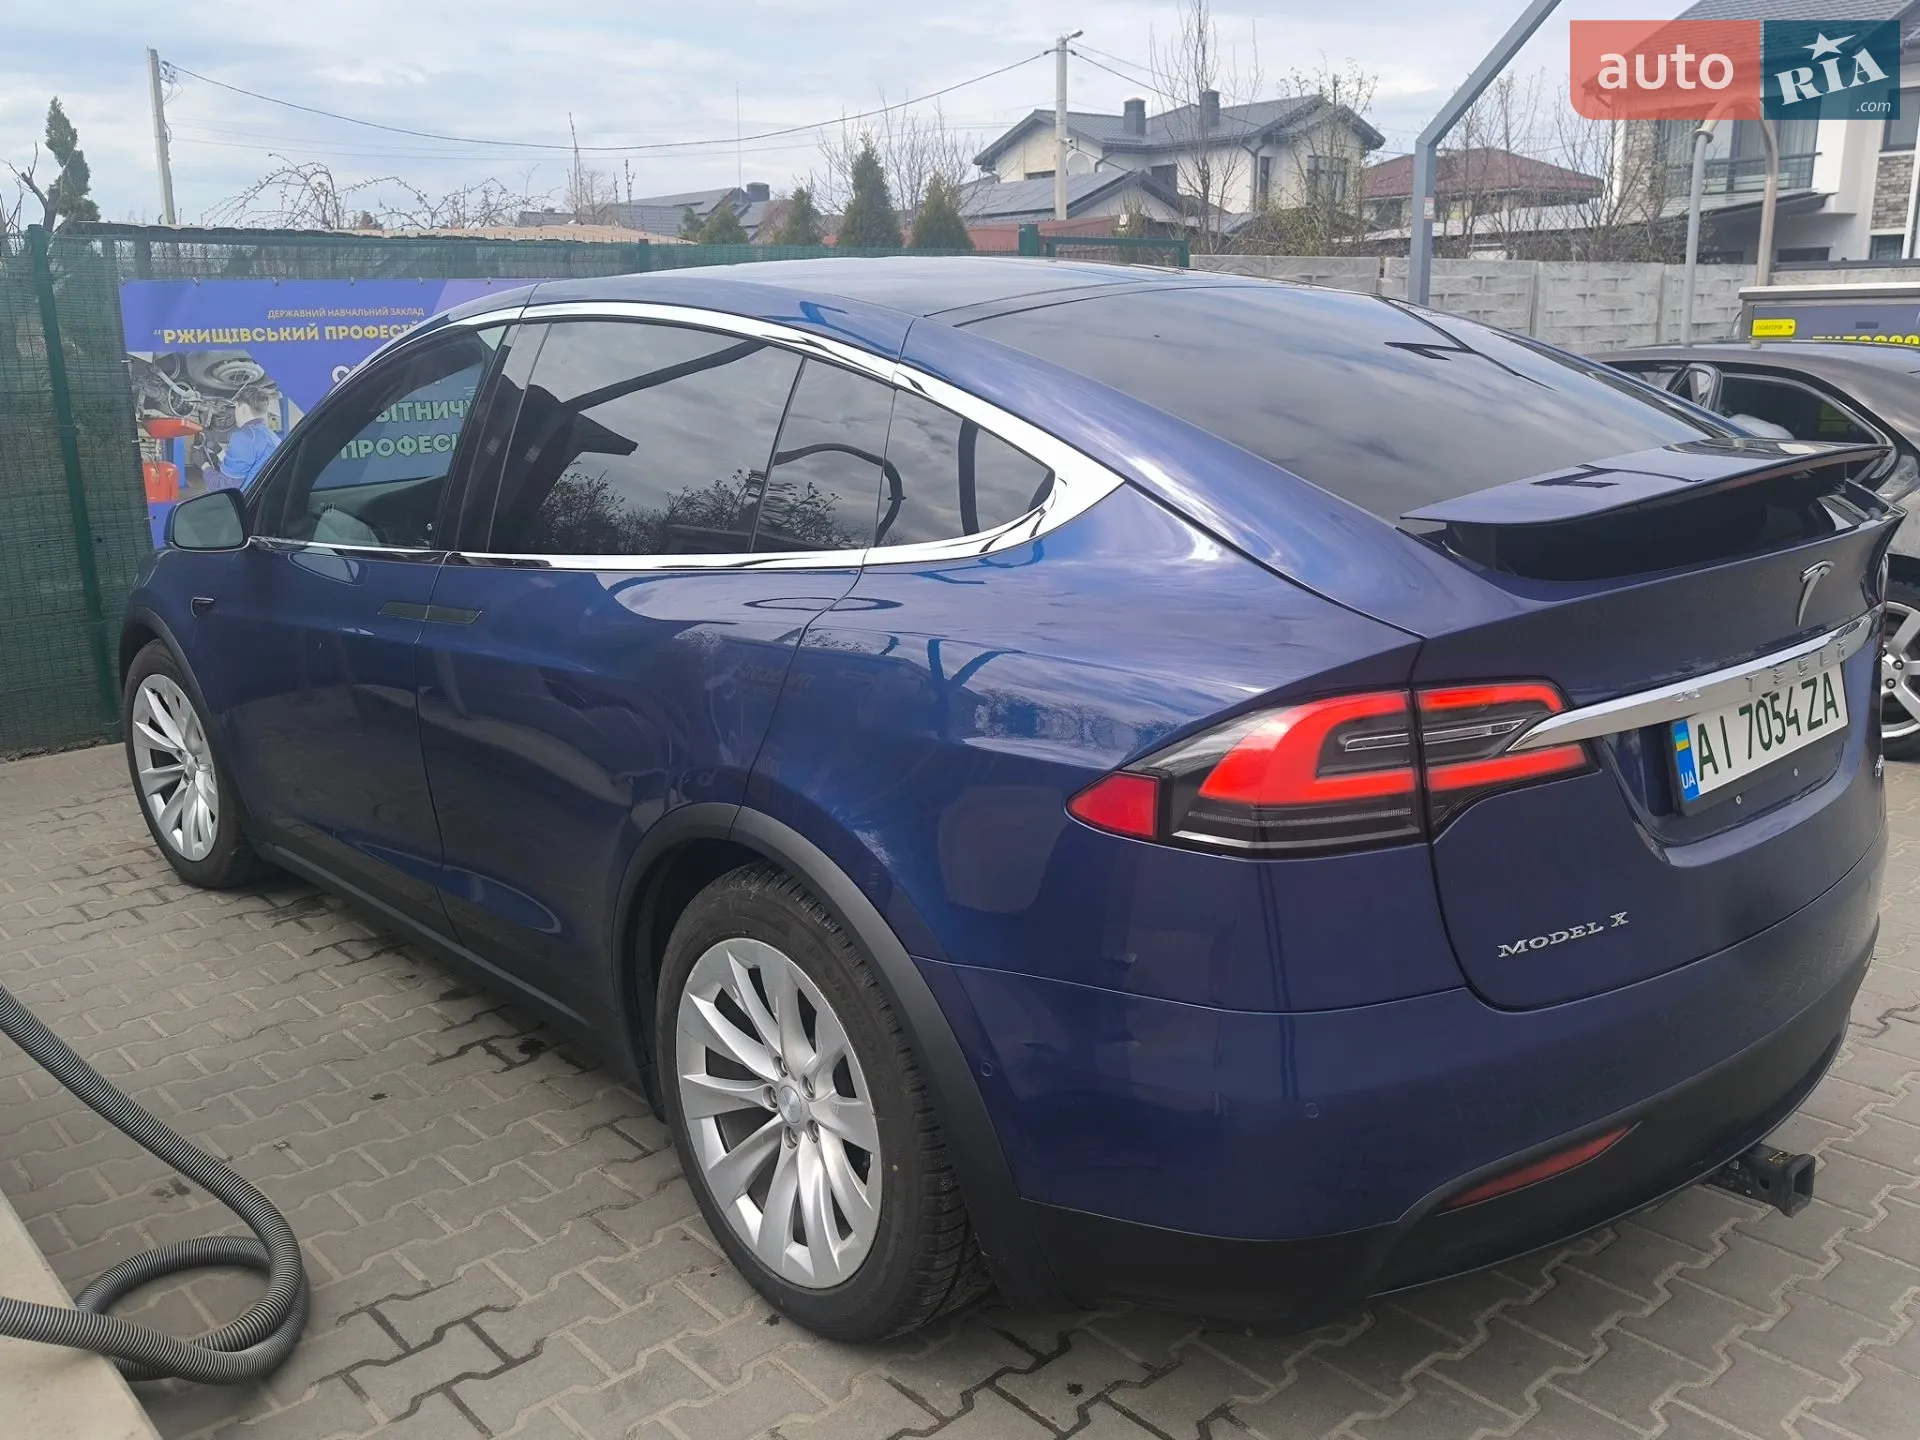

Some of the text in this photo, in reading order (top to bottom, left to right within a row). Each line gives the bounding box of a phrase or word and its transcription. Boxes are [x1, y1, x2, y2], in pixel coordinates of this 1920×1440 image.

[267, 306, 425, 320] ДЕРЖАВНИЙ НАВЧАЛЬНИЙ ЗАКЛАД
[340, 433, 459, 460] ПРОФЕСІ
[1697, 671, 1840, 782] AI 7054 ZA
[1681, 771, 1697, 790] UA
[1497, 911, 1630, 958] MODEL X
